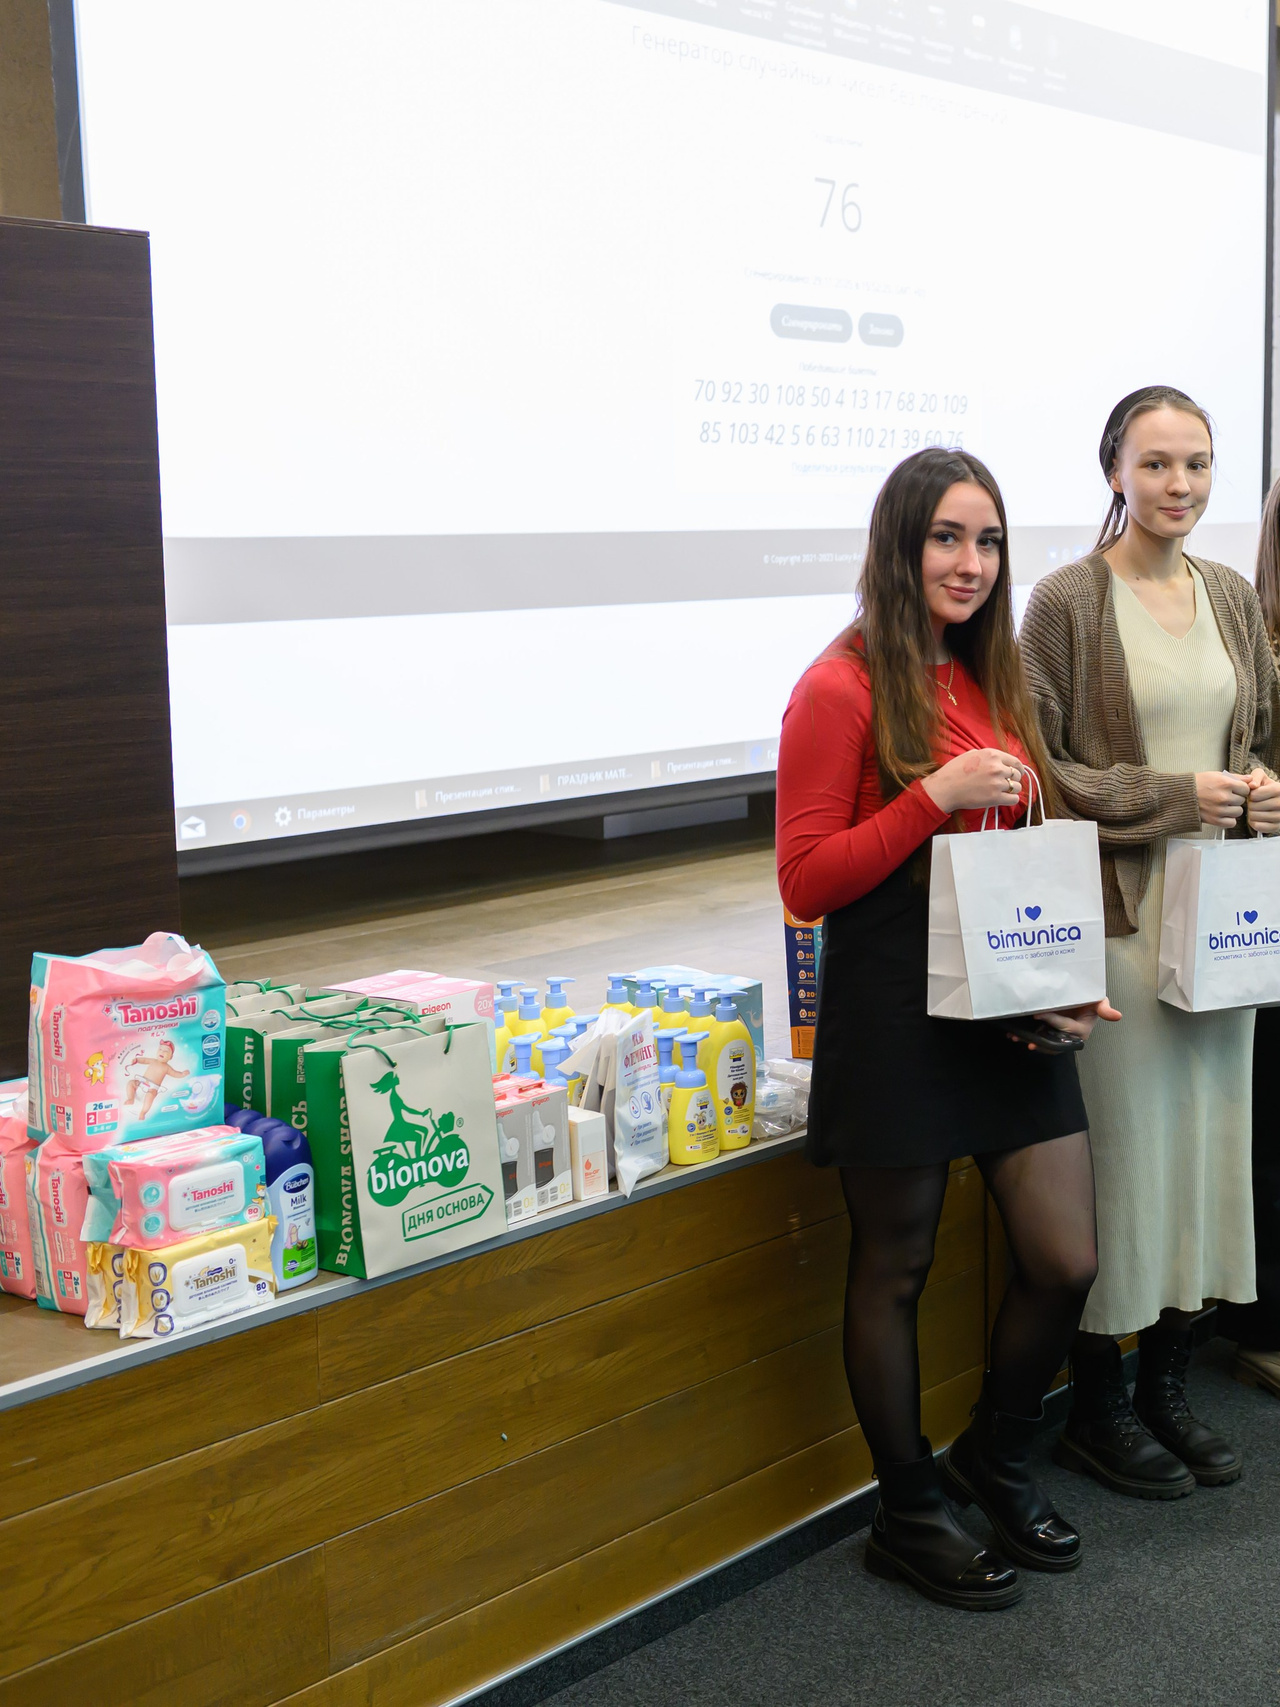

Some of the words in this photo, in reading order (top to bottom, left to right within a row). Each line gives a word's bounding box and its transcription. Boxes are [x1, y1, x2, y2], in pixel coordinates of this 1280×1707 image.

[814, 176, 862, 233] 76
[694, 379, 716, 402] 70
[721, 380, 743, 404] 92
[748, 382, 770, 404] 30
[776, 384, 805, 407] 108
[811, 386, 831, 408] 50
[835, 388, 845, 408] 4
[851, 389, 869, 410] 13
[875, 390, 893, 410] 17
[897, 391, 915, 412] 68
[919, 393, 937, 413] 20
[943, 394, 968, 414] 109
[699, 421, 721, 444] 85
[728, 422, 759, 445] 103
[764, 423, 785, 446] 42
[790, 424, 800, 446] 5
[806, 425, 816, 447] 6
[821, 425, 840, 447] 63
[847, 427, 874, 448] 110
[878, 428, 896, 449] 21
[901, 429, 920, 449] 39
[297, 805, 355, 820] Параметры
[987, 924, 1081, 950] bimunica
[93, 1103, 103, 1111] 26
[88, 1114, 95, 1124] 2
[105, 1111, 112, 1121] S
[369, 1148, 469, 1194] bionova
[285, 1177, 309, 1191] Bübchen
[291, 1194, 307, 1207] Milk
[247, 1207, 259, 1215] 80
[407, 1209, 434, 1232] ДНЯ
[436, 1193, 485, 1219] ОСНОВА
[256, 1282, 267, 1291] 80
